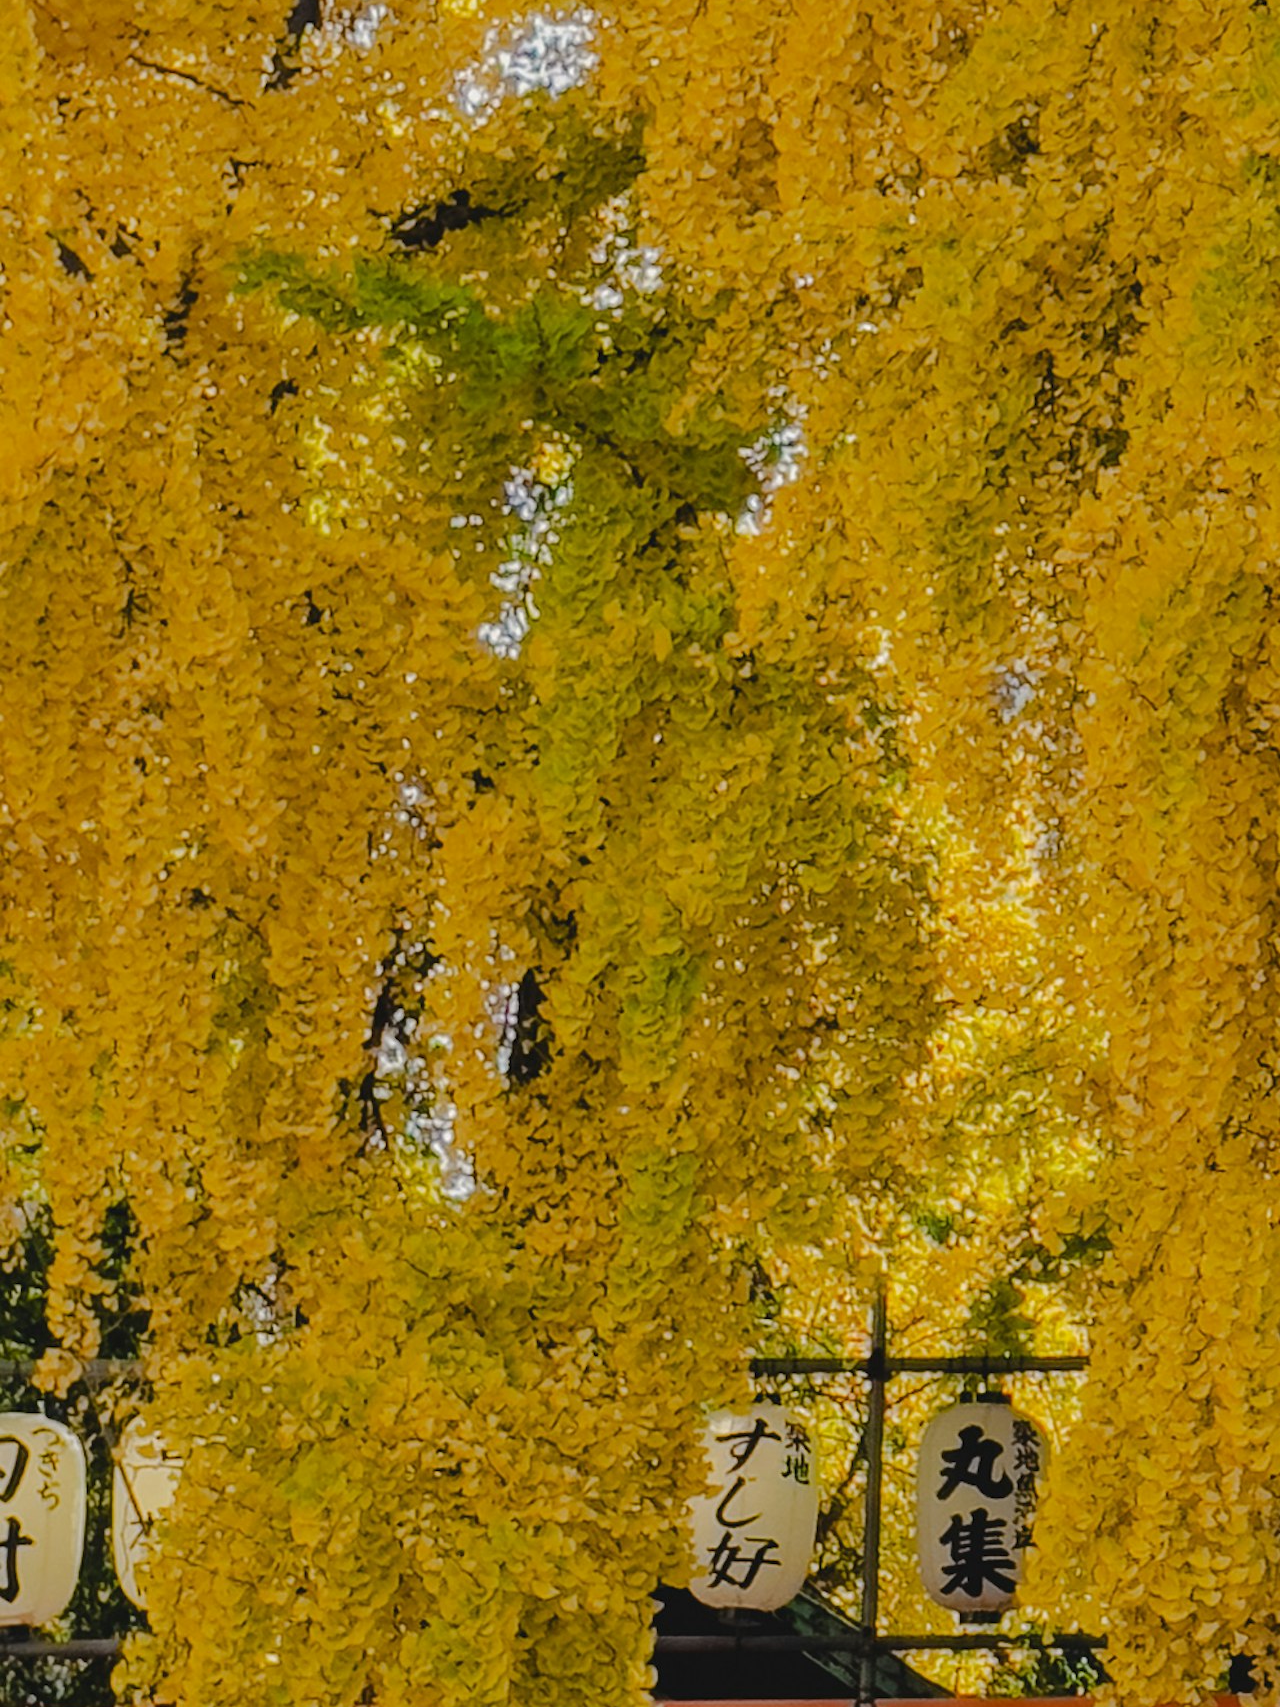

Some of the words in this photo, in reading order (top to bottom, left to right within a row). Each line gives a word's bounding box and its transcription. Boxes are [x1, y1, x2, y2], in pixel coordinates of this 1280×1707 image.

[705, 1416, 782, 1590] すし好
[936, 1423, 1018, 1598] 丸集
